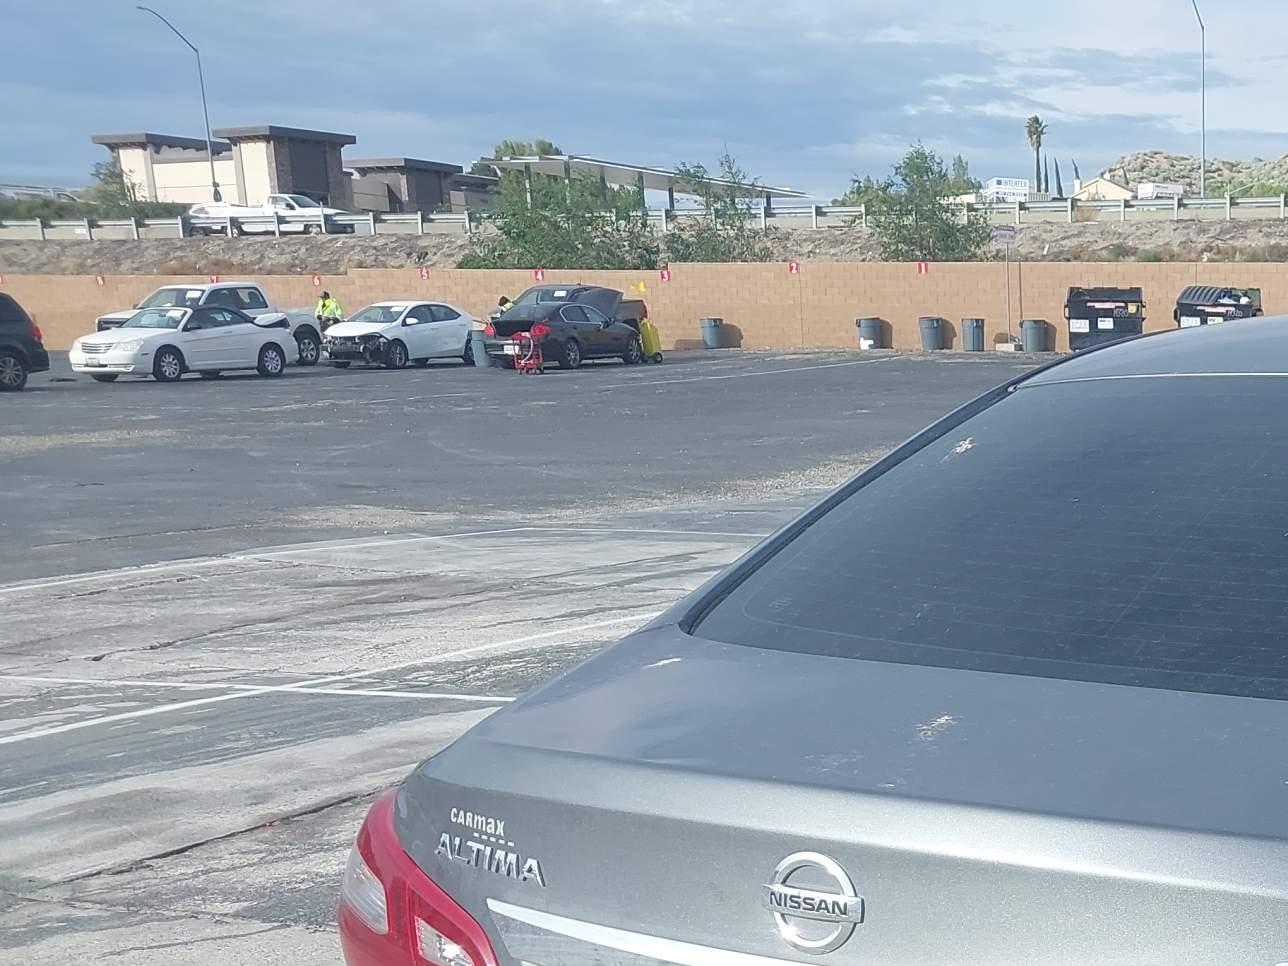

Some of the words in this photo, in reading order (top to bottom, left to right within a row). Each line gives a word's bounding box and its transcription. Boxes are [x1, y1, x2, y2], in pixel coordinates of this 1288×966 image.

[421, 267, 428, 280] 5
[790, 262, 797, 274] 2
[313, 275, 320, 286] 6
[536, 270, 543, 281] 4
[661, 271, 668, 281] 3
[433, 832, 547, 887] ALTIMA
[768, 890, 849, 918] NISSAN
